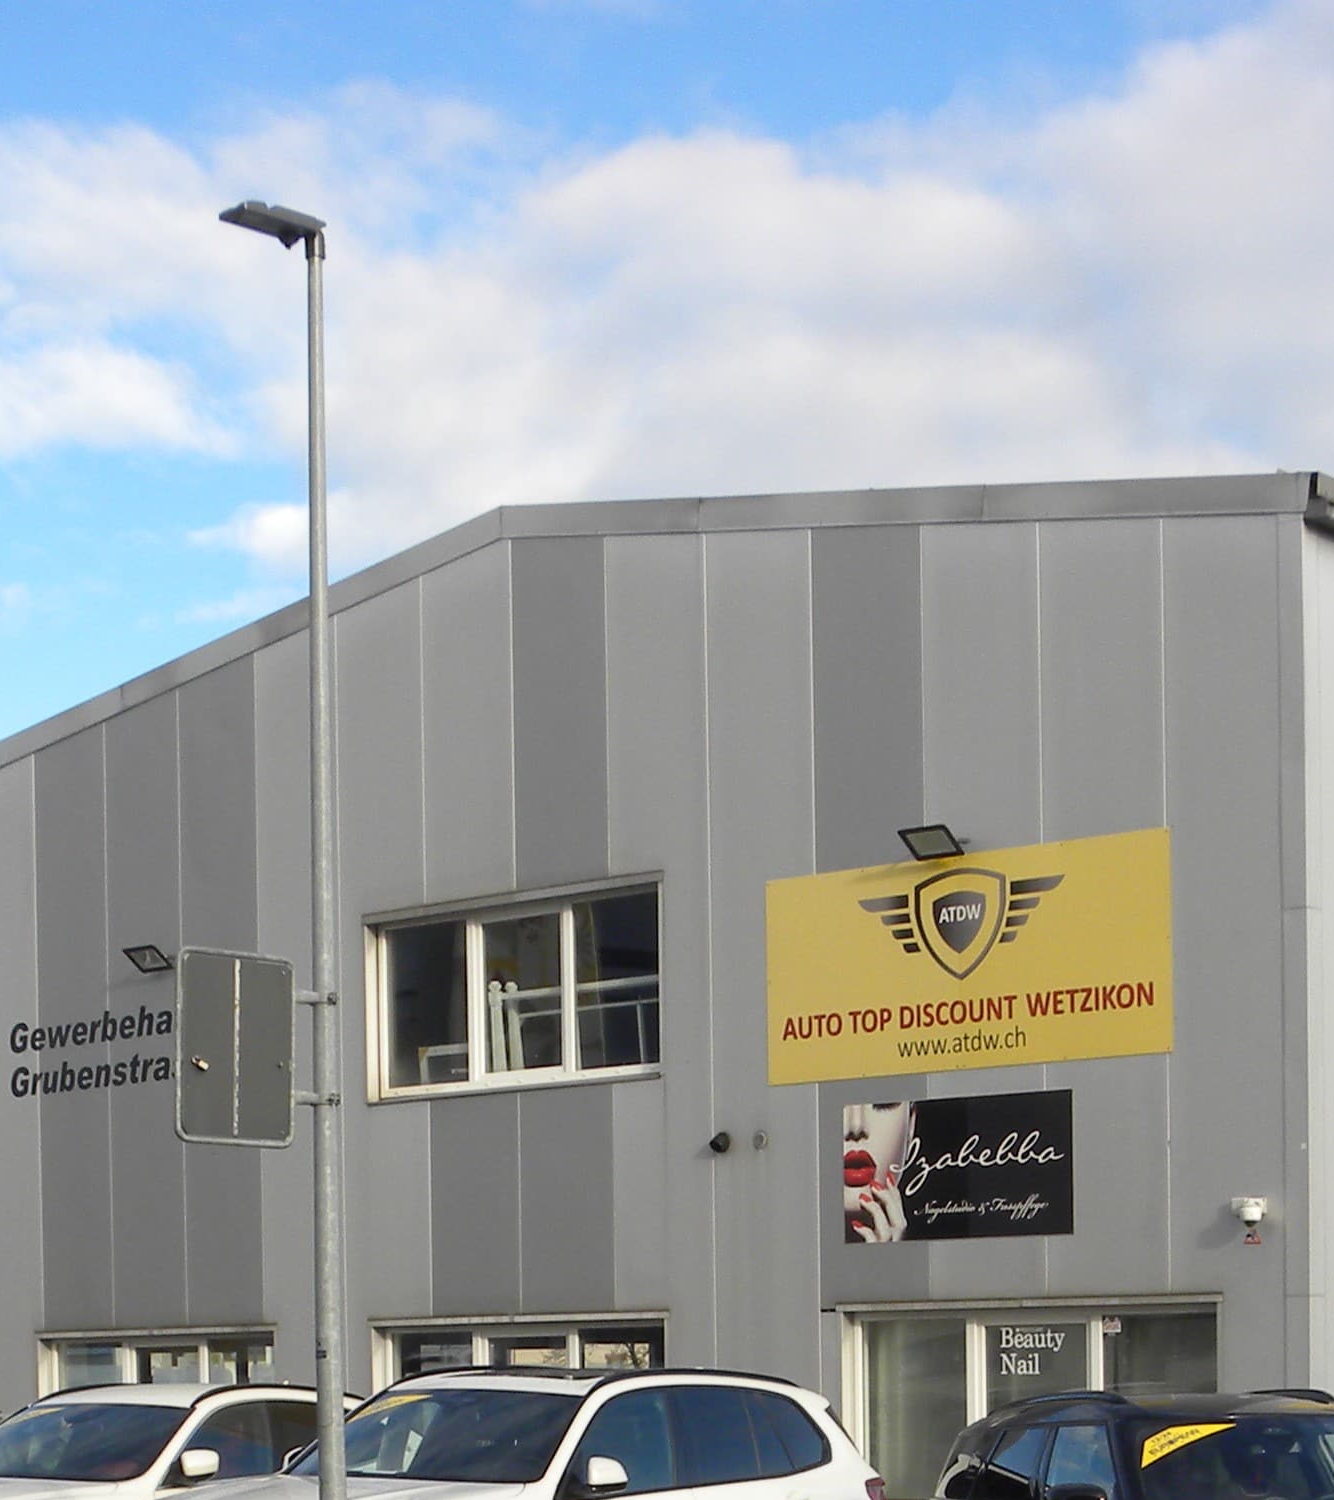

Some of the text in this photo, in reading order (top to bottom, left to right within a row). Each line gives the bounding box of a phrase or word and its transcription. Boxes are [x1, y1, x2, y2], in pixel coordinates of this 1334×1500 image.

[939, 903, 981, 924] ATDW
[782, 981, 1155, 1042] AUTO TOP DISCOUNT WETZIKON
[9, 1005, 173, 1054] Gewerbeha
[897, 1025, 1027, 1059] www.atdw.ch
[11, 1053, 176, 1098] Grubenstra
[1000, 1327, 1065, 1352] Beauty
[1000, 1353, 1040, 1375] Nail
